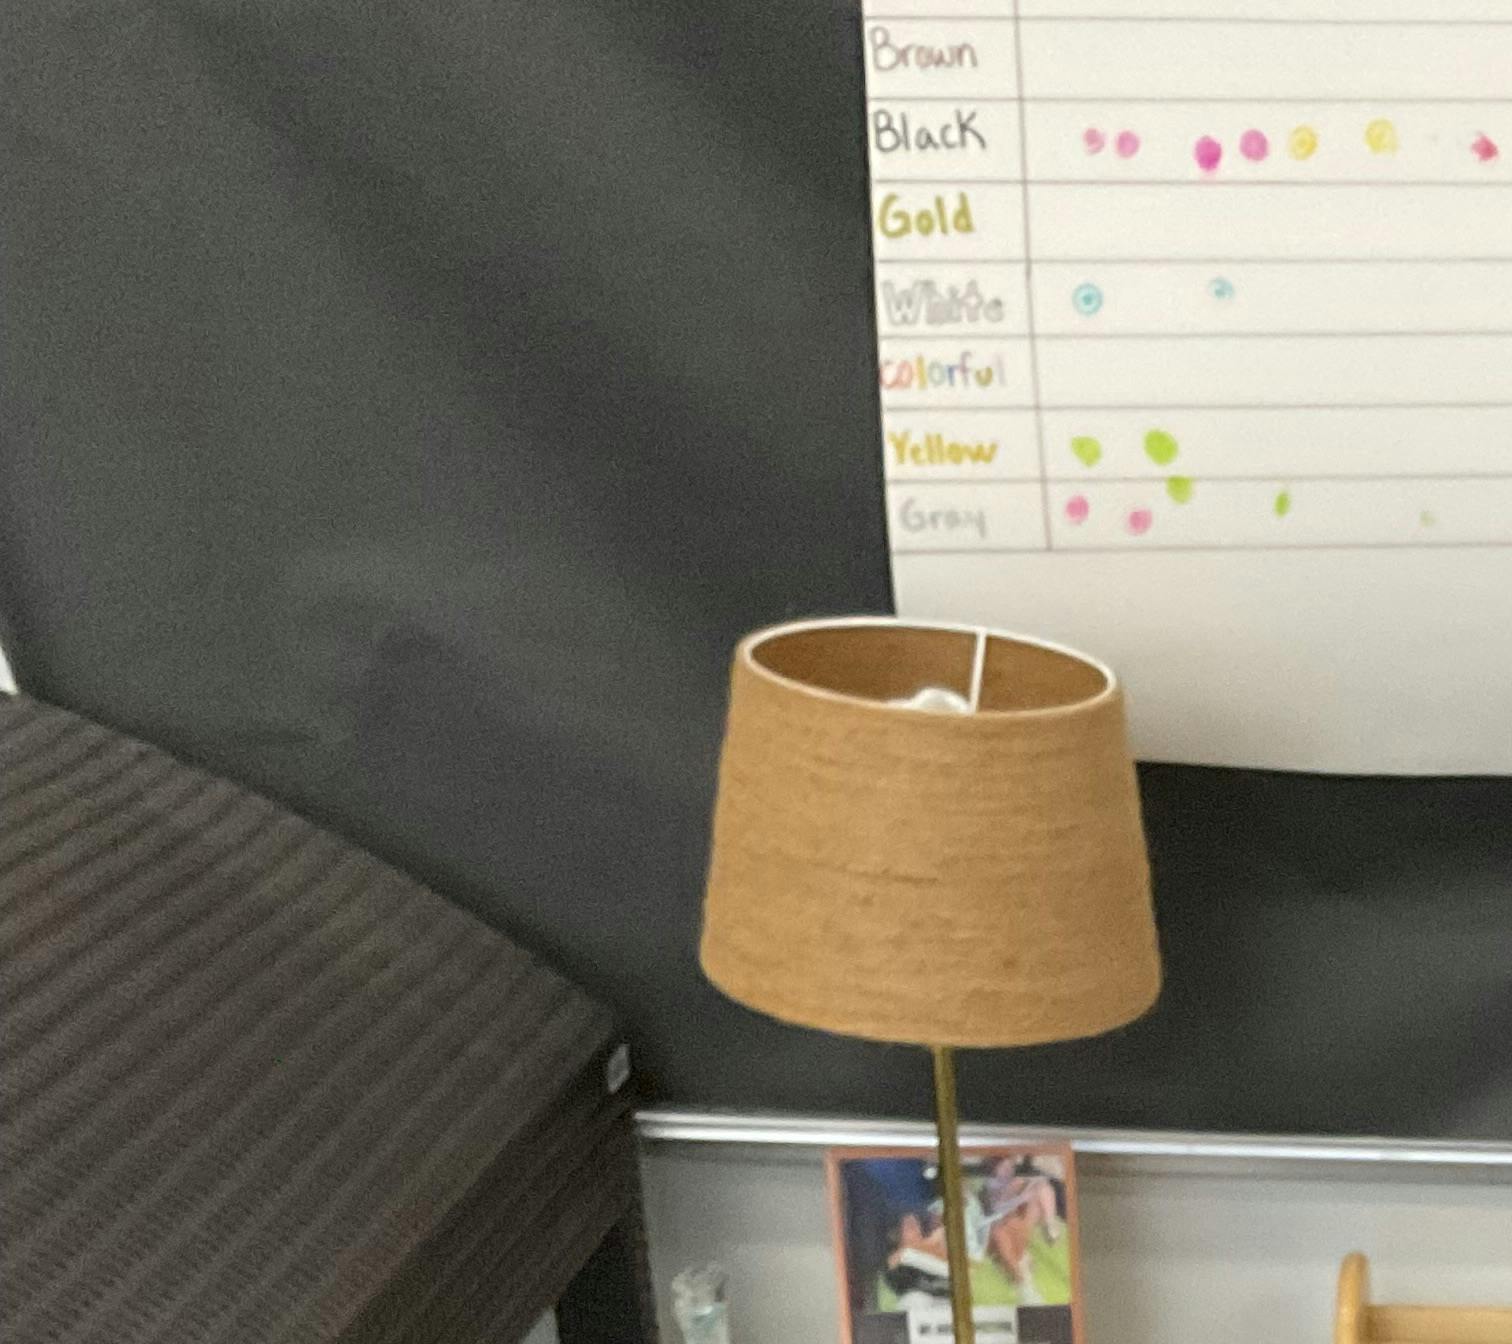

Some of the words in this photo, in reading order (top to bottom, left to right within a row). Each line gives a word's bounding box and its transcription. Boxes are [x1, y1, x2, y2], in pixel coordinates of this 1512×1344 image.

[869, 25, 978, 72] Brown
[872, 108, 987, 152] Black
[879, 192, 975, 239] Gold
[887, 430, 999, 466] Yellow
[899, 498, 988, 540] Gray
